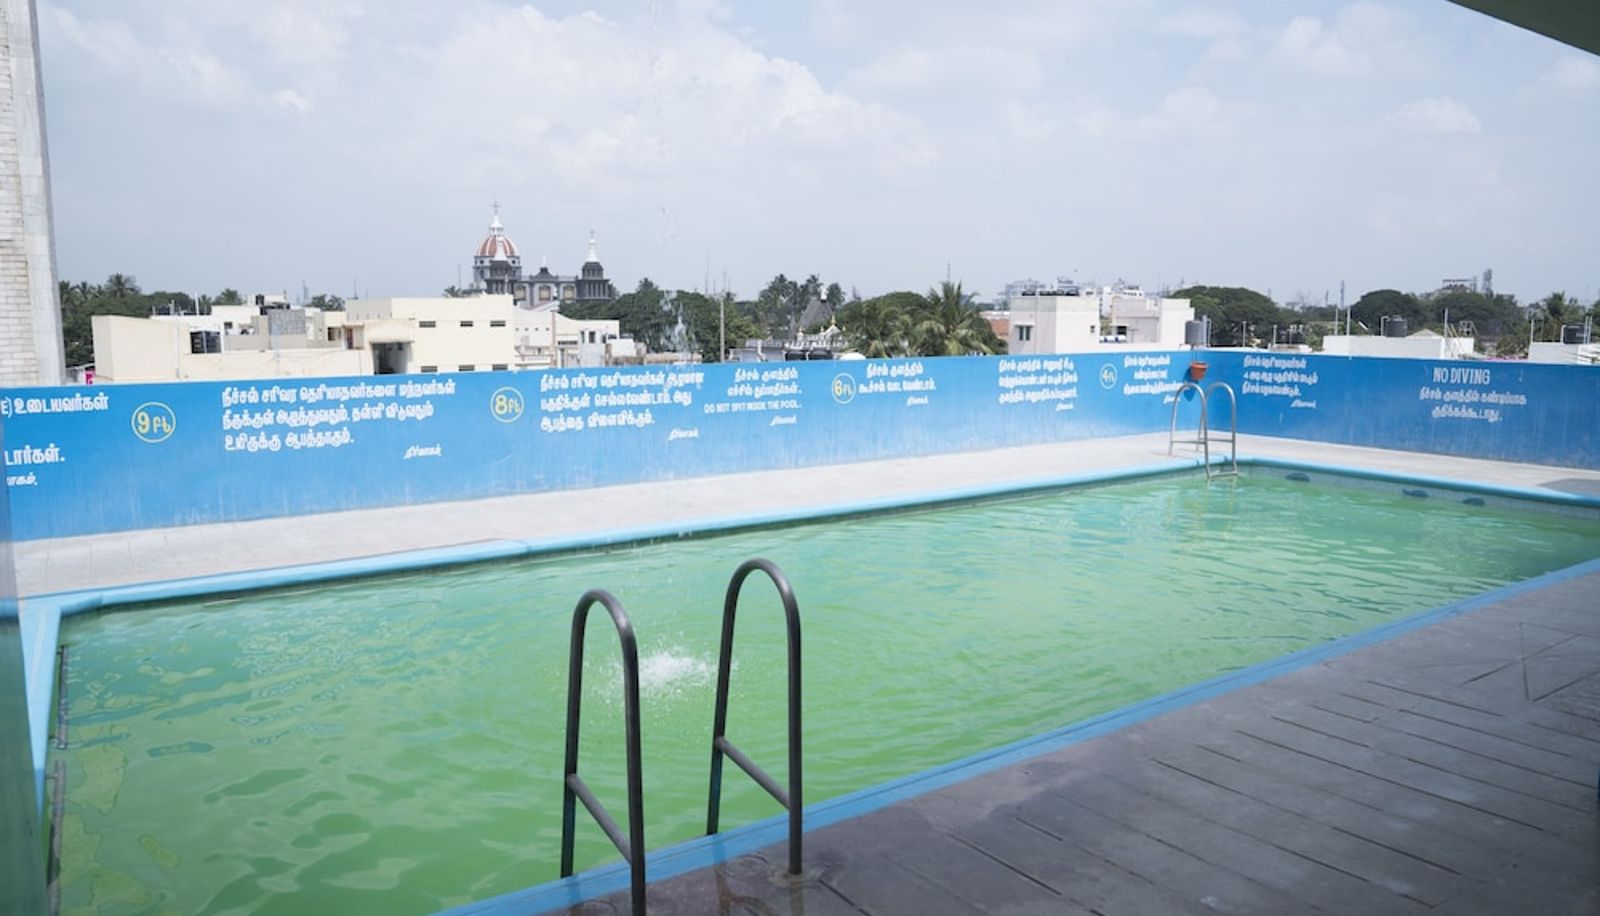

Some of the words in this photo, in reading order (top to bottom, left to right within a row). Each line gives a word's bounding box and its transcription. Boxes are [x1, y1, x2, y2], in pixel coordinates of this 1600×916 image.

[1433, 367, 1448, 384] NO
[1449, 367, 1490, 385] DIVING
[222, 386, 260, 407] நீச்சல்
